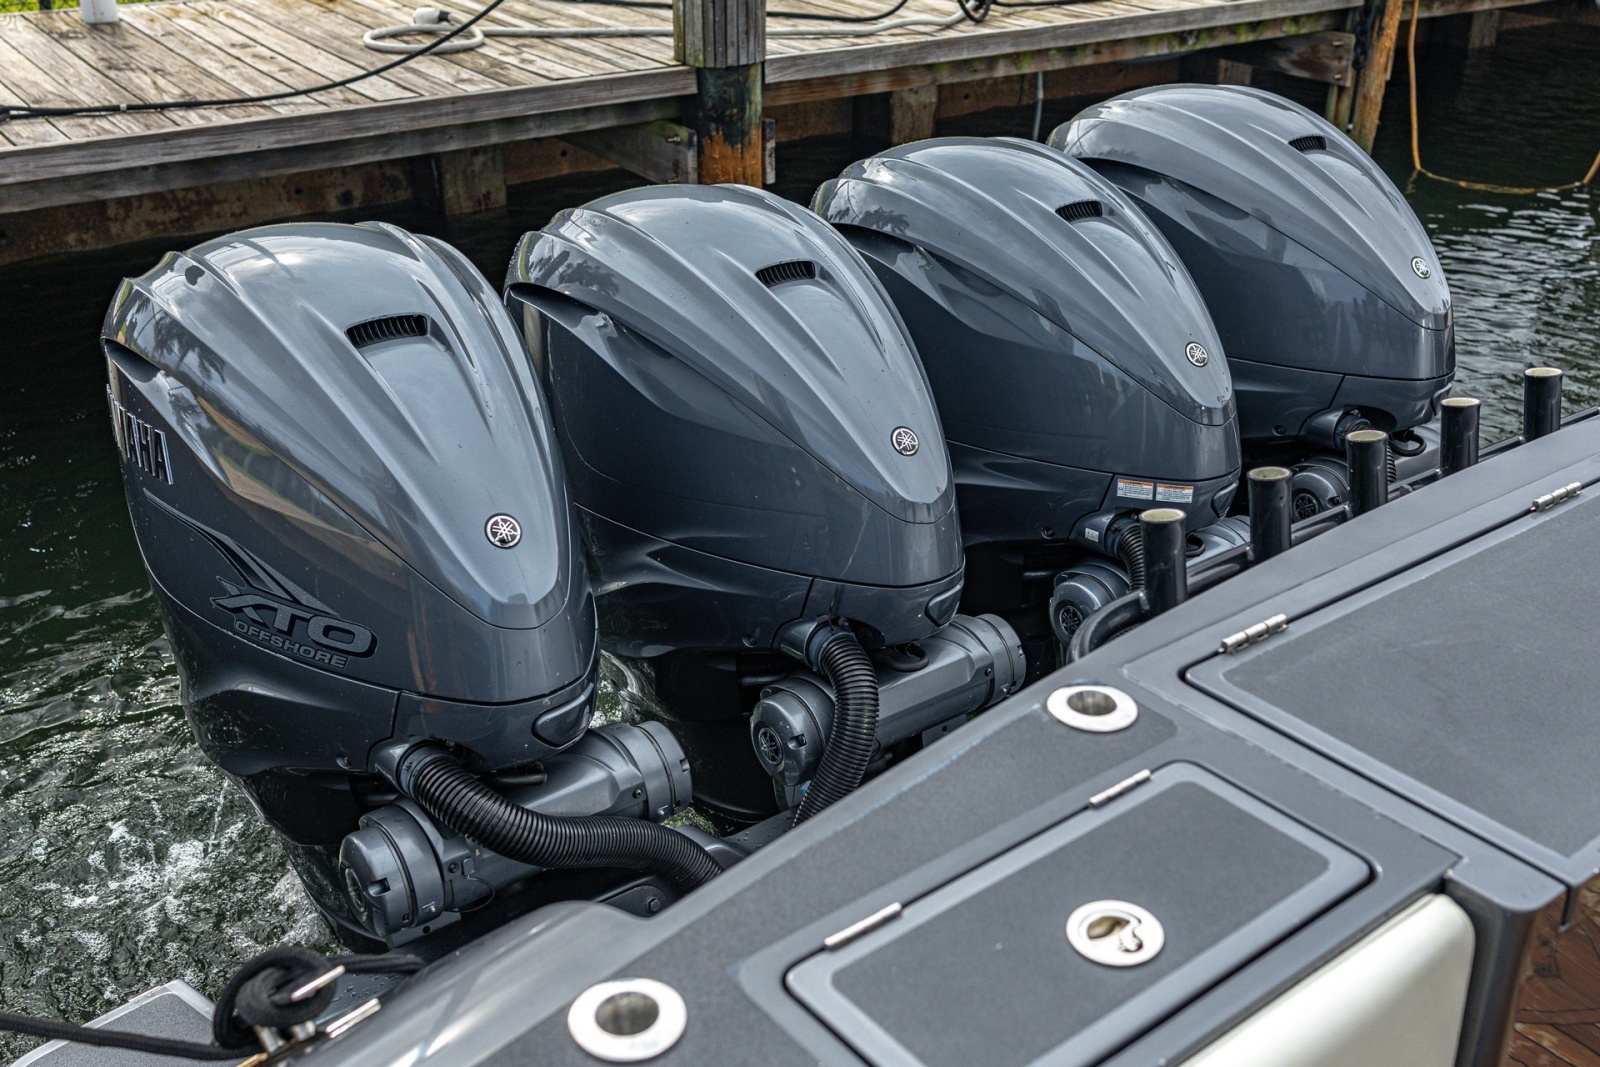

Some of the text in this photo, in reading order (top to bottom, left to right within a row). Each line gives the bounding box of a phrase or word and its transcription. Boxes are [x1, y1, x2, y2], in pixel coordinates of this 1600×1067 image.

[106, 384, 174, 485] MAHA
[212, 577, 375, 655] XTO
[235, 620, 347, 669] OFFSHORE
